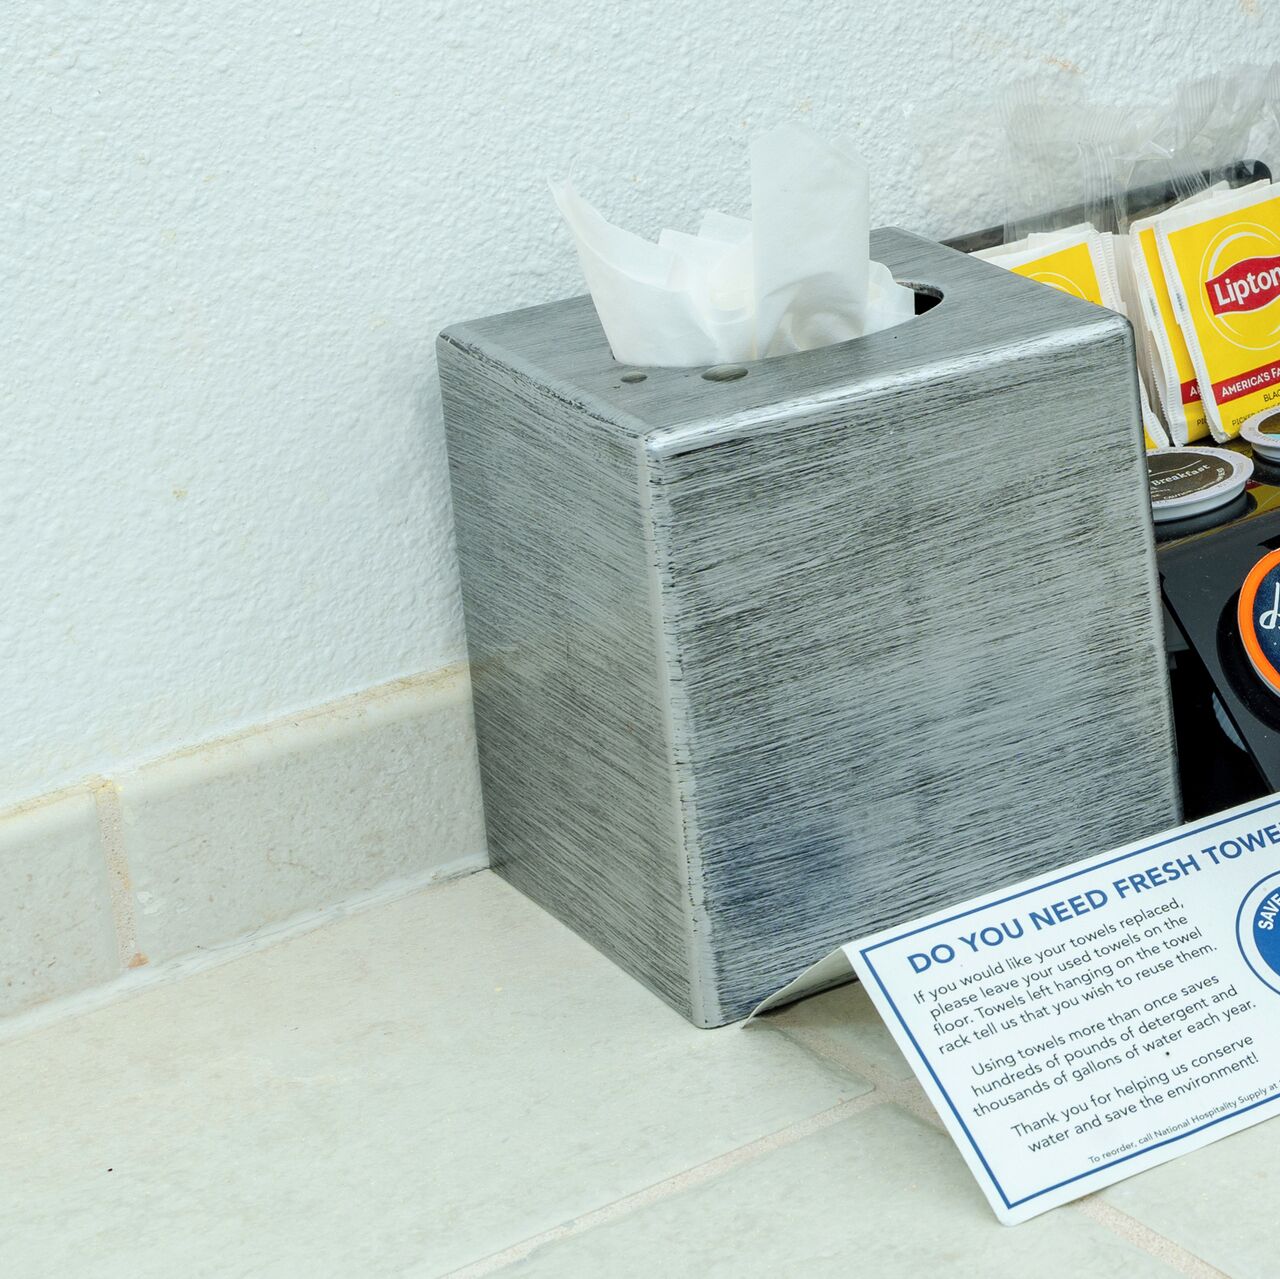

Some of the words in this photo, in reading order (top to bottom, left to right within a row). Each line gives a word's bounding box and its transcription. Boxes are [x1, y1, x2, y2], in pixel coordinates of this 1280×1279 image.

[1221, 372, 1271, 398] AMERICA'S
[1151, 464, 1211, 486] Breakfast
[906, 943, 956, 975] DO
[957, 917, 1025, 953] YOU
[1028, 888, 1109, 932] NEED
[1111, 853, 1202, 900] FRESH
[913, 989, 926, 1005] If
[928, 981, 958, 1003] you
[959, 961, 1006, 987] would
[1004, 955, 1033, 971] like
[1034, 942, 1066, 964] your
[1068, 923, 1118, 948] towels
[1119, 896, 1184, 929] replaced,
[929, 993, 979, 1022] please
[978, 979, 1020, 999] leave
[1020, 966, 1053, 988] your
[1056, 949, 1093, 972] used
[1092, 932, 1142, 958] towels
[1143, 925, 1163, 938] on
[1163, 916, 1189, 930] the
[933, 1015, 974, 1037] floor.
[973, 994, 1026, 1019] Towels
[1025, 984, 1054, 1002] left
[1052, 964, 1115, 992] hanging
[1115, 955, 1135, 969] on
[1135, 945, 1161, 961] the
[1161, 925, 1203, 950] towel
[938, 1033, 972, 1055] rack
[972, 1021, 999, 1041] tell
[1000, 1018, 1019, 1031] us
[1019, 1005, 1051, 1024] that
[1051, 996, 1080, 1016] you
[1080, 981, 1115, 1002] wish
[1108, 976, 1133, 988] to
[1135, 959, 1175, 981] reuse
[1175, 944, 1218, 964] them.
[970, 1062, 1043, 1098] hundreds
[1045, 1053, 1061, 1069] of
[1063, 1035, 1118, 1067] pounds
[1119, 1025, 1135, 1042] of
[1138, 997, 1210, 1035] detergent
[1210, 983, 1239, 1004] and
[971, 1054, 1017, 1076] Using
[1016, 1034, 1067, 1059] towels
[1068, 1021, 1106, 1042] more
[1107, 1008, 1142, 1027] than
[1143, 992, 1179, 1012] once
[1180, 975, 1220, 997] saves
[972, 1079, 1051, 1118] thousands
[1053, 1069, 1069, 1086] of
[1071, 1055, 1123, 1083] gallons
[1125, 1043, 1140, 1060] of
[1141, 1029, 1183, 1053] water
[1186, 1012, 1221, 1034] each
[1221, 1000, 1257, 1023] year.
[1010, 1111, 1060, 1137] Thank
[1060, 1102, 1090, 1123] you
[1089, 1092, 1112, 1108] for
[1112, 1072, 1170, 1099] helping
[1170, 1063, 1189, 1077] us
[1191, 1036, 1254, 1068] conserve
[1027, 1129, 1070, 1153] water
[1074, 1113, 1103, 1135] and
[1104, 1104, 1138, 1123] save
[1138, 1092, 1165, 1109] the
[1165, 1050, 1259, 1099] environment!
[1087, 1155, 1101, 1164] To
[1101, 1141, 1138, 1160] reorder,
[1137, 1132, 1154, 1145] call
[1153, 1118, 1191, 1139] National
[1190, 1099, 1238, 1124] Hospitality
[1237, 1087, 1268, 1104] Supply
[1268, 1082, 1279, 1092] at
